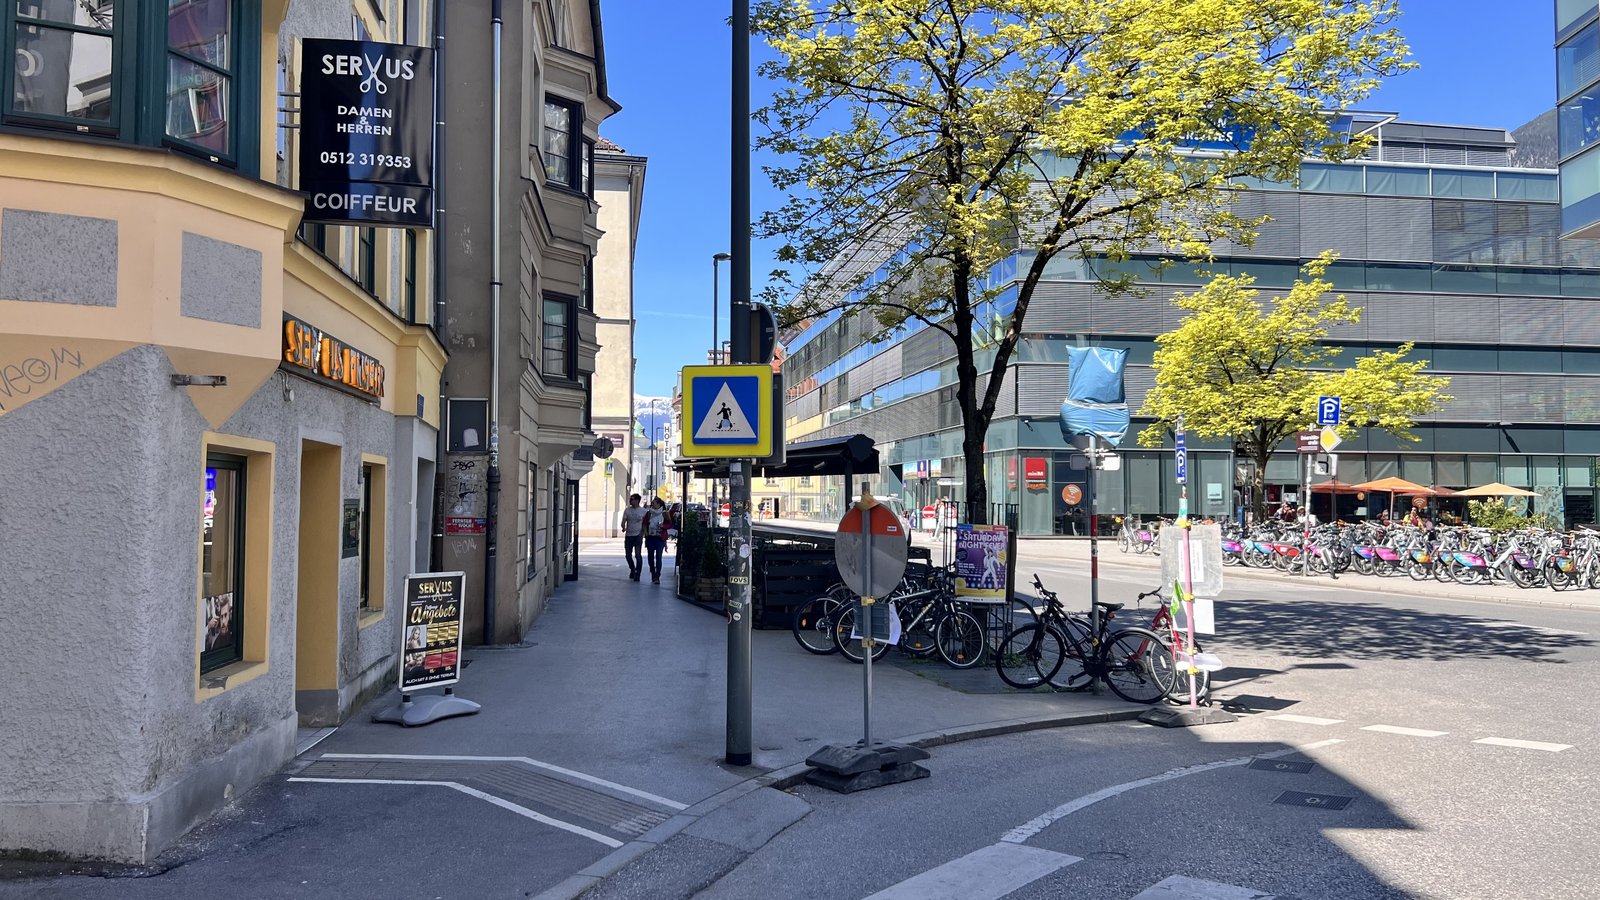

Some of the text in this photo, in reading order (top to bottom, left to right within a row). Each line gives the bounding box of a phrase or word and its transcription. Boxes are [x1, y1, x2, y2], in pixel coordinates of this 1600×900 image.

[321, 53, 414, 86] SERVUS
[337, 106, 392, 118] DAMEN
[336, 123, 392, 136] HERREN
[359, 117, 369, 125] &
[320, 151, 411, 168] 0512 319353
[313, 192, 417, 214] COIFFEUR
[1323, 402, 1336, 419] P
[959, 541, 1005, 550] NIGHT FEVER
[411, 603, 457, 625] Angebote
